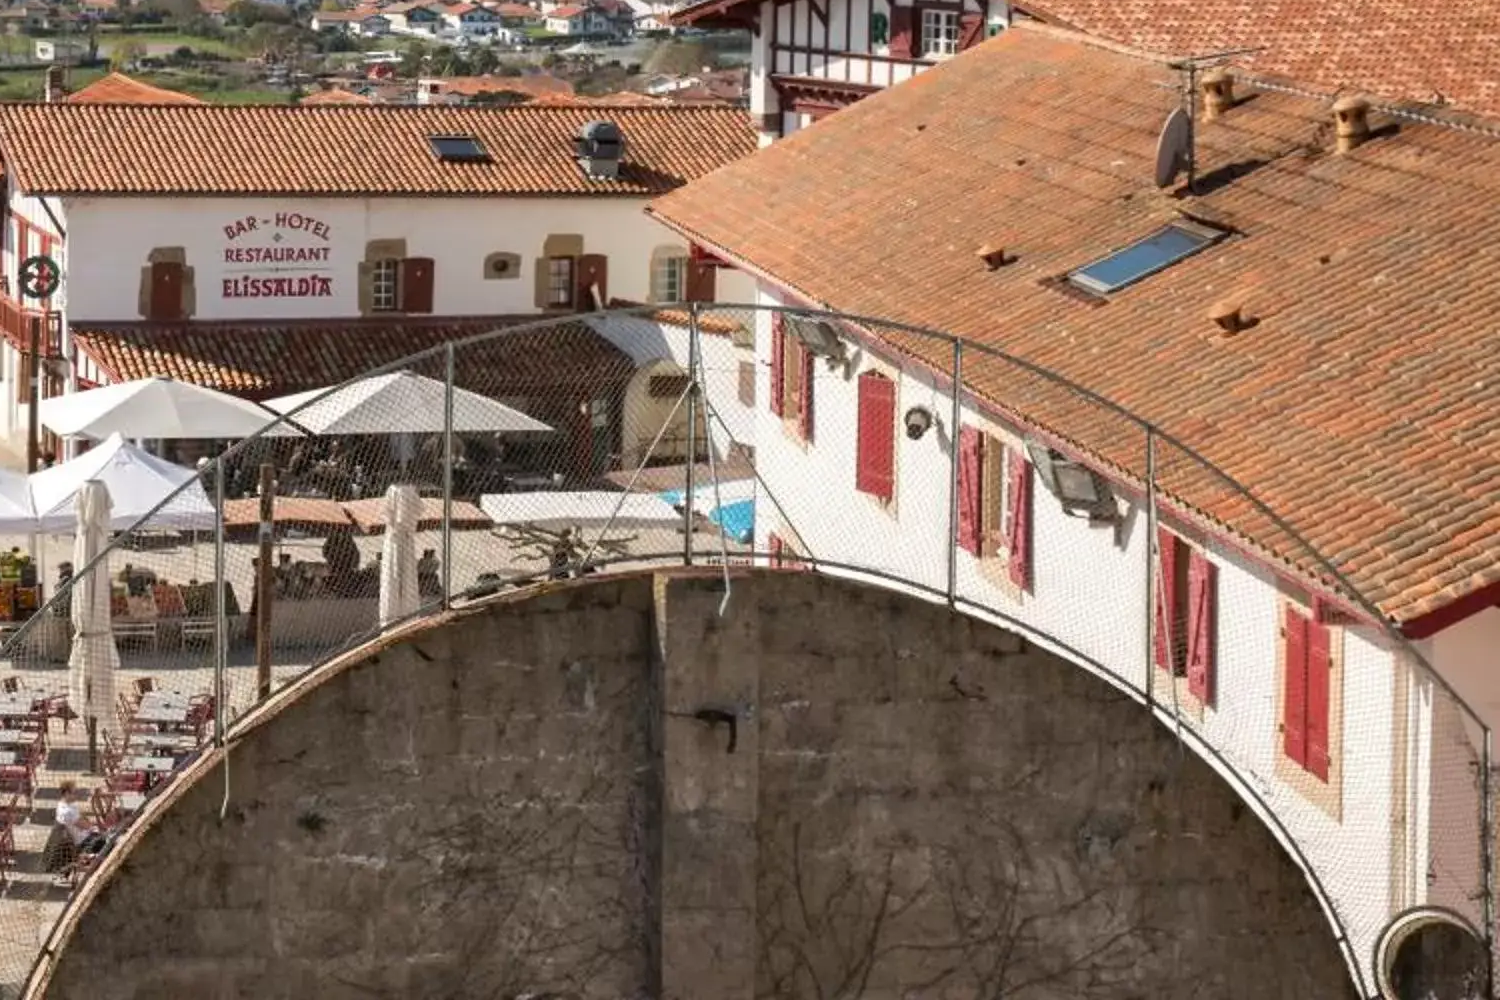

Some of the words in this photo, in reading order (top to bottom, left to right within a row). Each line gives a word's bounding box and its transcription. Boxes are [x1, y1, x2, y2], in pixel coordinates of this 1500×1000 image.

[224, 216, 258, 240] BAR
[275, 212, 331, 241] HOTEL
[225, 247, 331, 263] RESTAURANT
